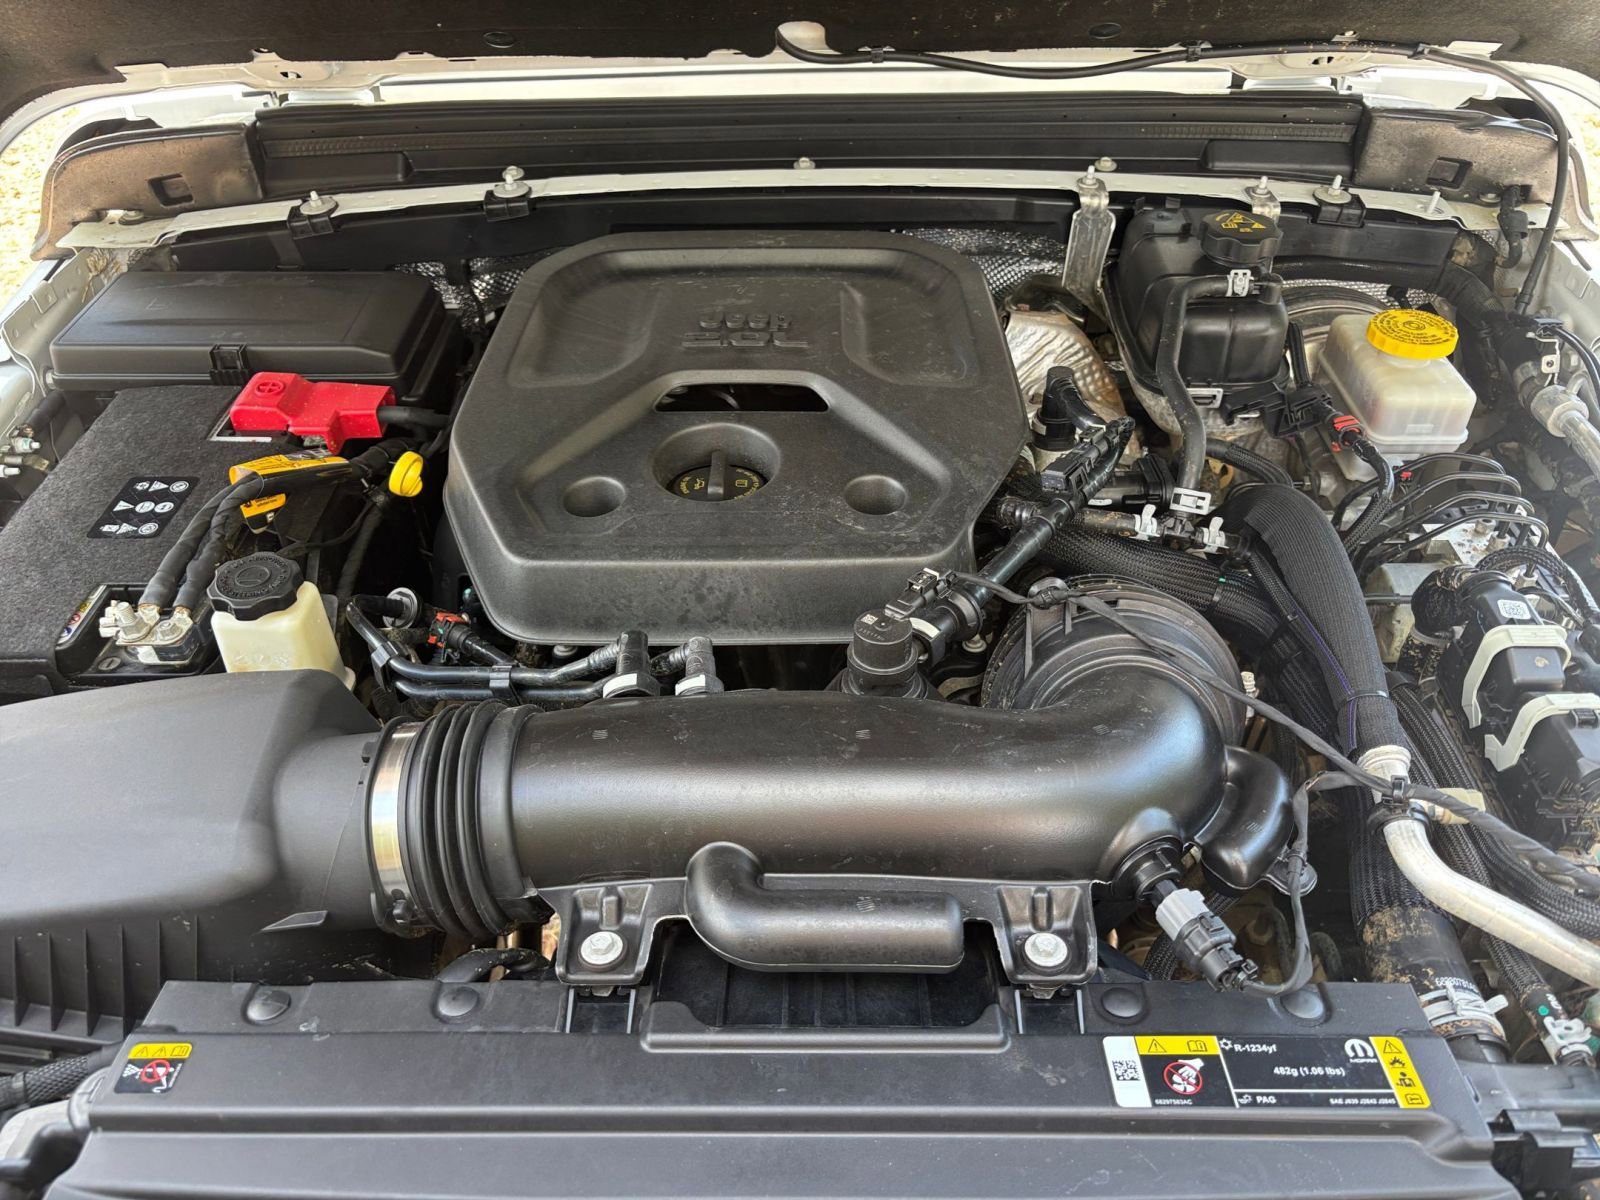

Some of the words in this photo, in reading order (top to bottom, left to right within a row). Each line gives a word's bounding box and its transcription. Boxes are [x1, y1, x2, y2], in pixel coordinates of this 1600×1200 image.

[1233, 1043, 1278, 1055] R-1234yf
[1273, 1066, 1299, 1077] 482g
[1299, 1066, 1325, 1077] (1.06
[1325, 1066, 1346, 1077] lbs)
[1256, 1095, 1277, 1104] PAG
